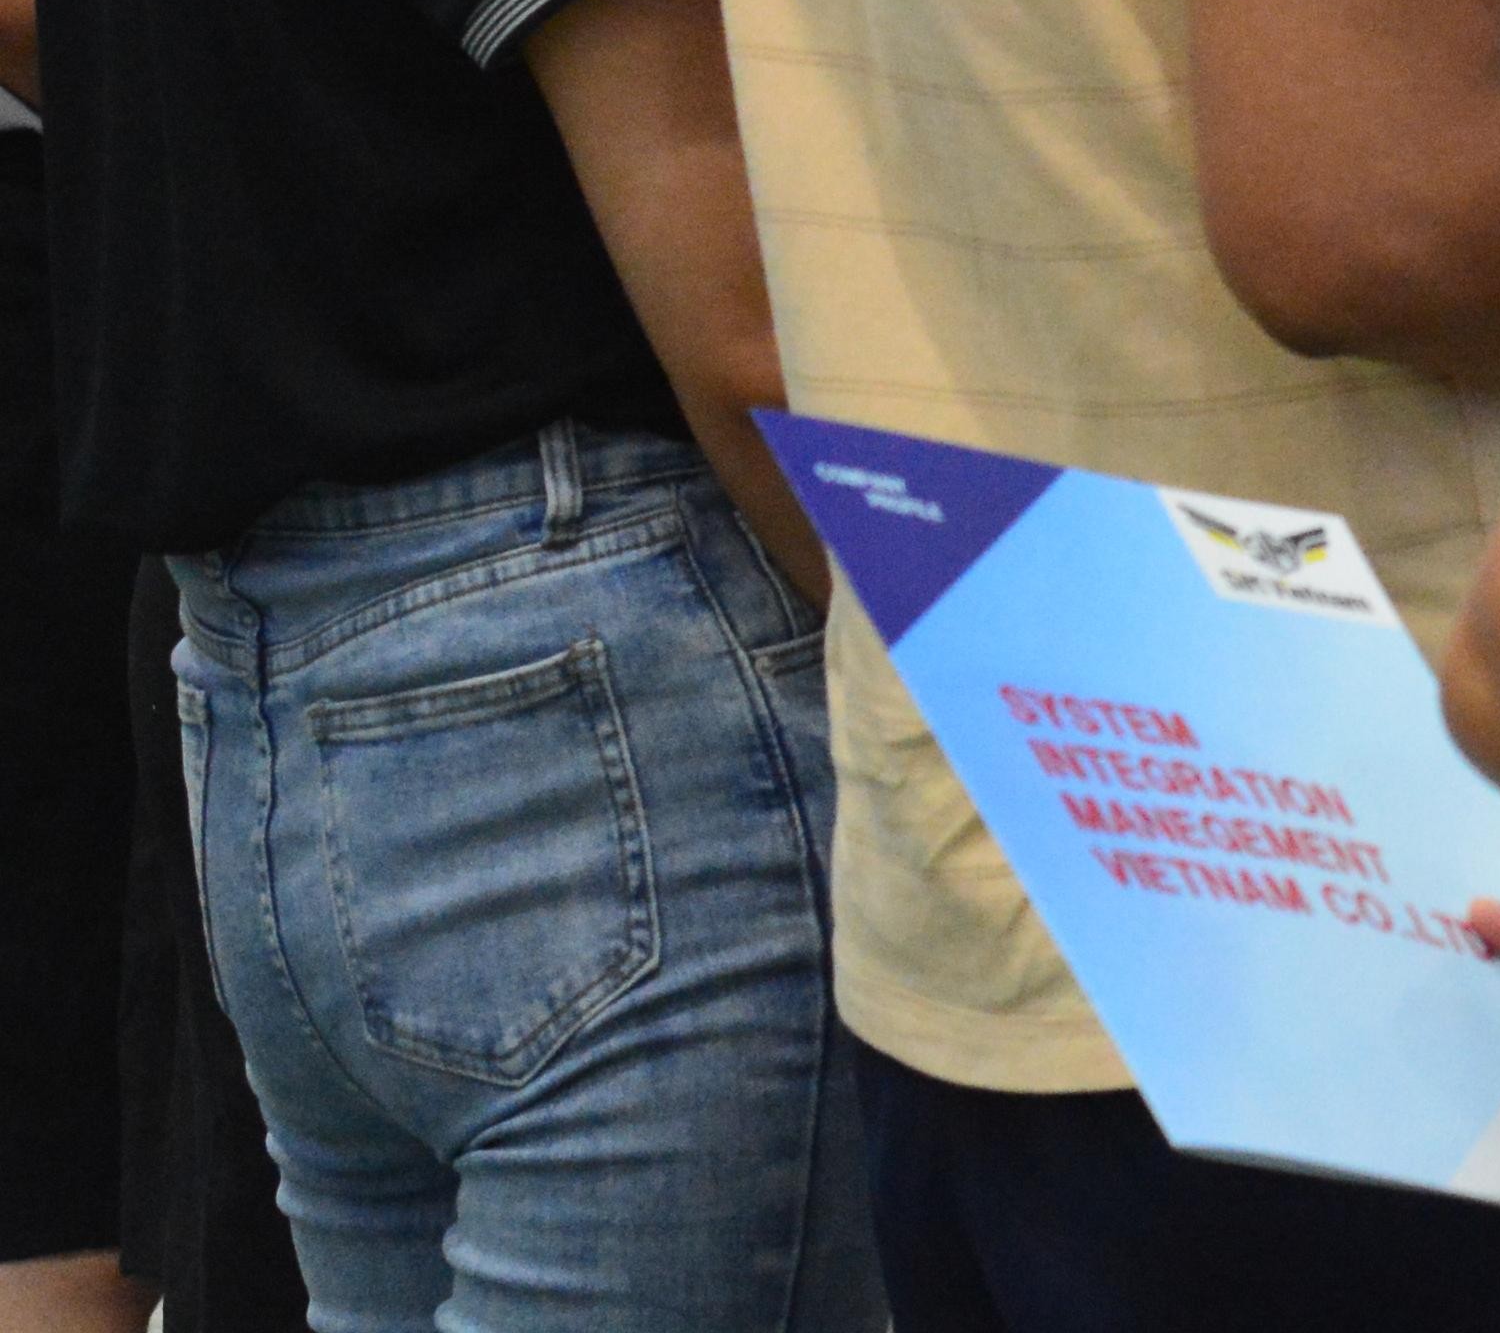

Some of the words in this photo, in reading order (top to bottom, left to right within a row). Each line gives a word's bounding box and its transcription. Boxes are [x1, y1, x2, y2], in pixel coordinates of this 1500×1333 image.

[998, 683, 1200, 750] SYSTEM
[1025, 736, 1356, 826] INTEGRATION
[1059, 790, 1390, 884] MANEGEMENT
[1088, 843, 1314, 917] VIETNAM
